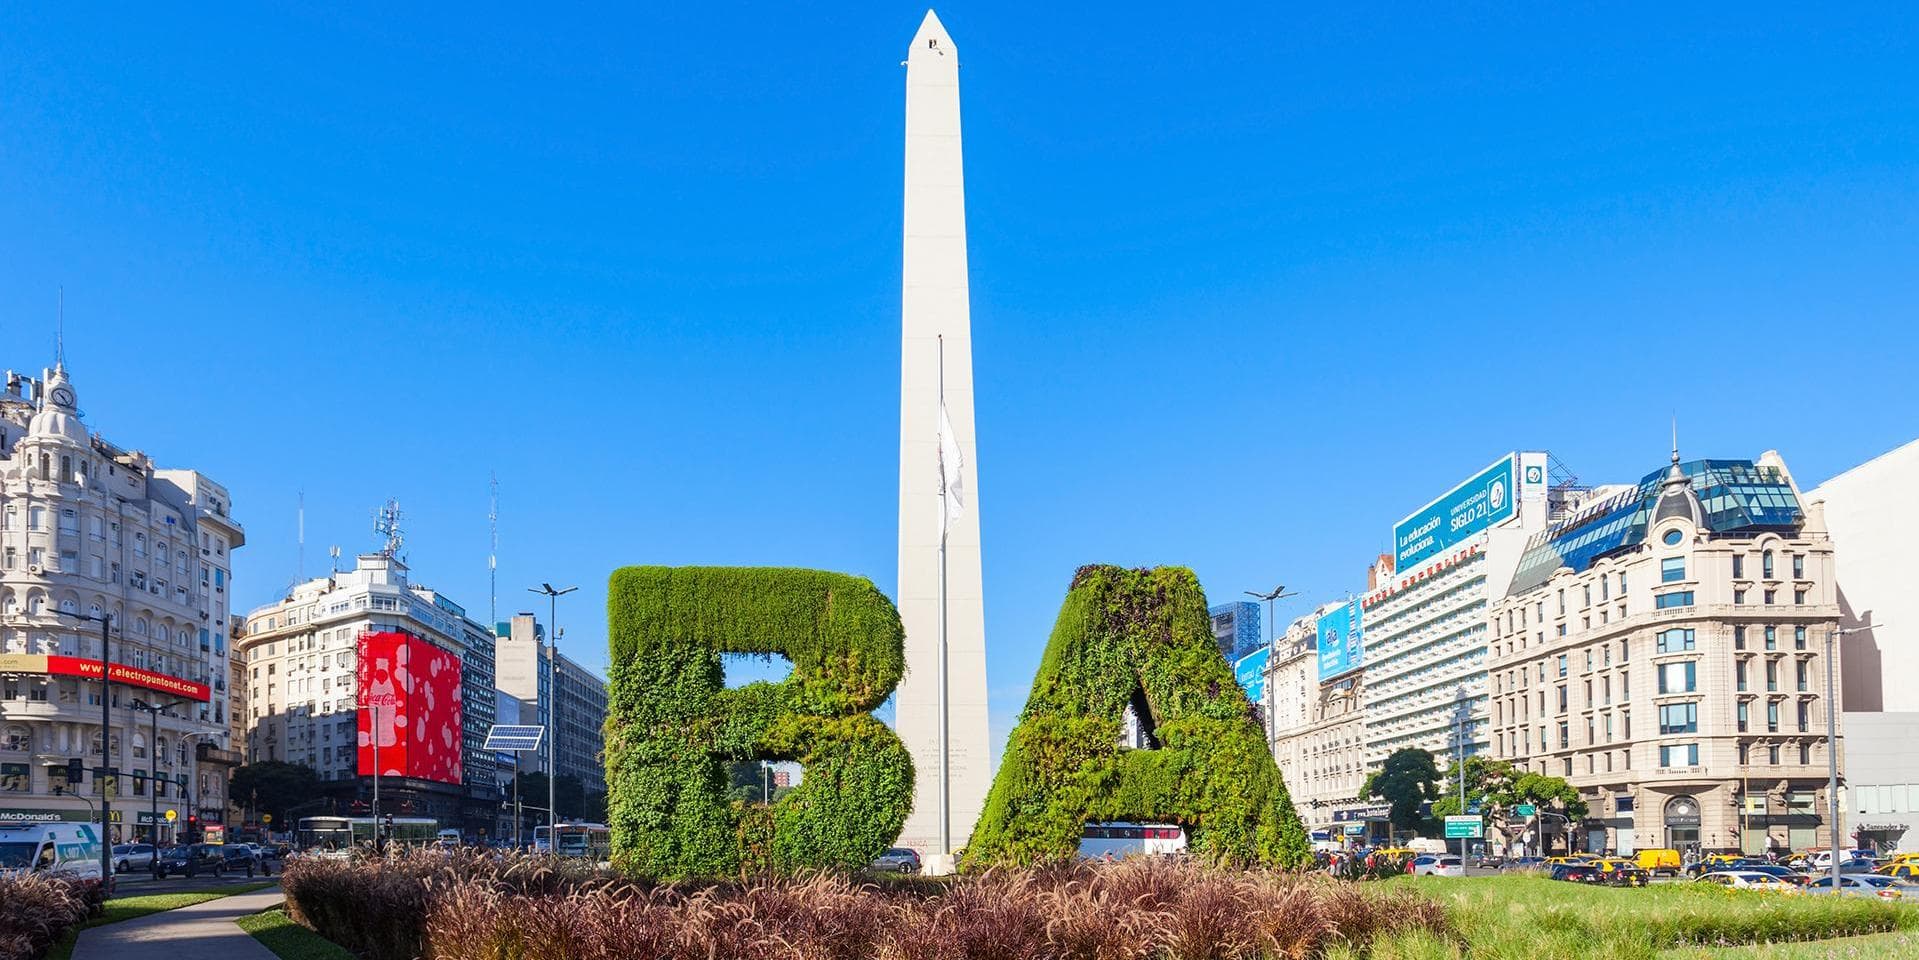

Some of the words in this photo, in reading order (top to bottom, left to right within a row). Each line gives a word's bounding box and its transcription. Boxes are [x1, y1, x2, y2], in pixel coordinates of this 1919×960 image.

[1450, 490, 1487, 516] UNIVERSIDAD
[1450, 508, 1475, 532] SIGLO
[1476, 501, 1487, 518] 21
[1400, 536, 1408, 547] La
[1408, 515, 1441, 543] educación
[0, 812, 61, 821] McDonald's
